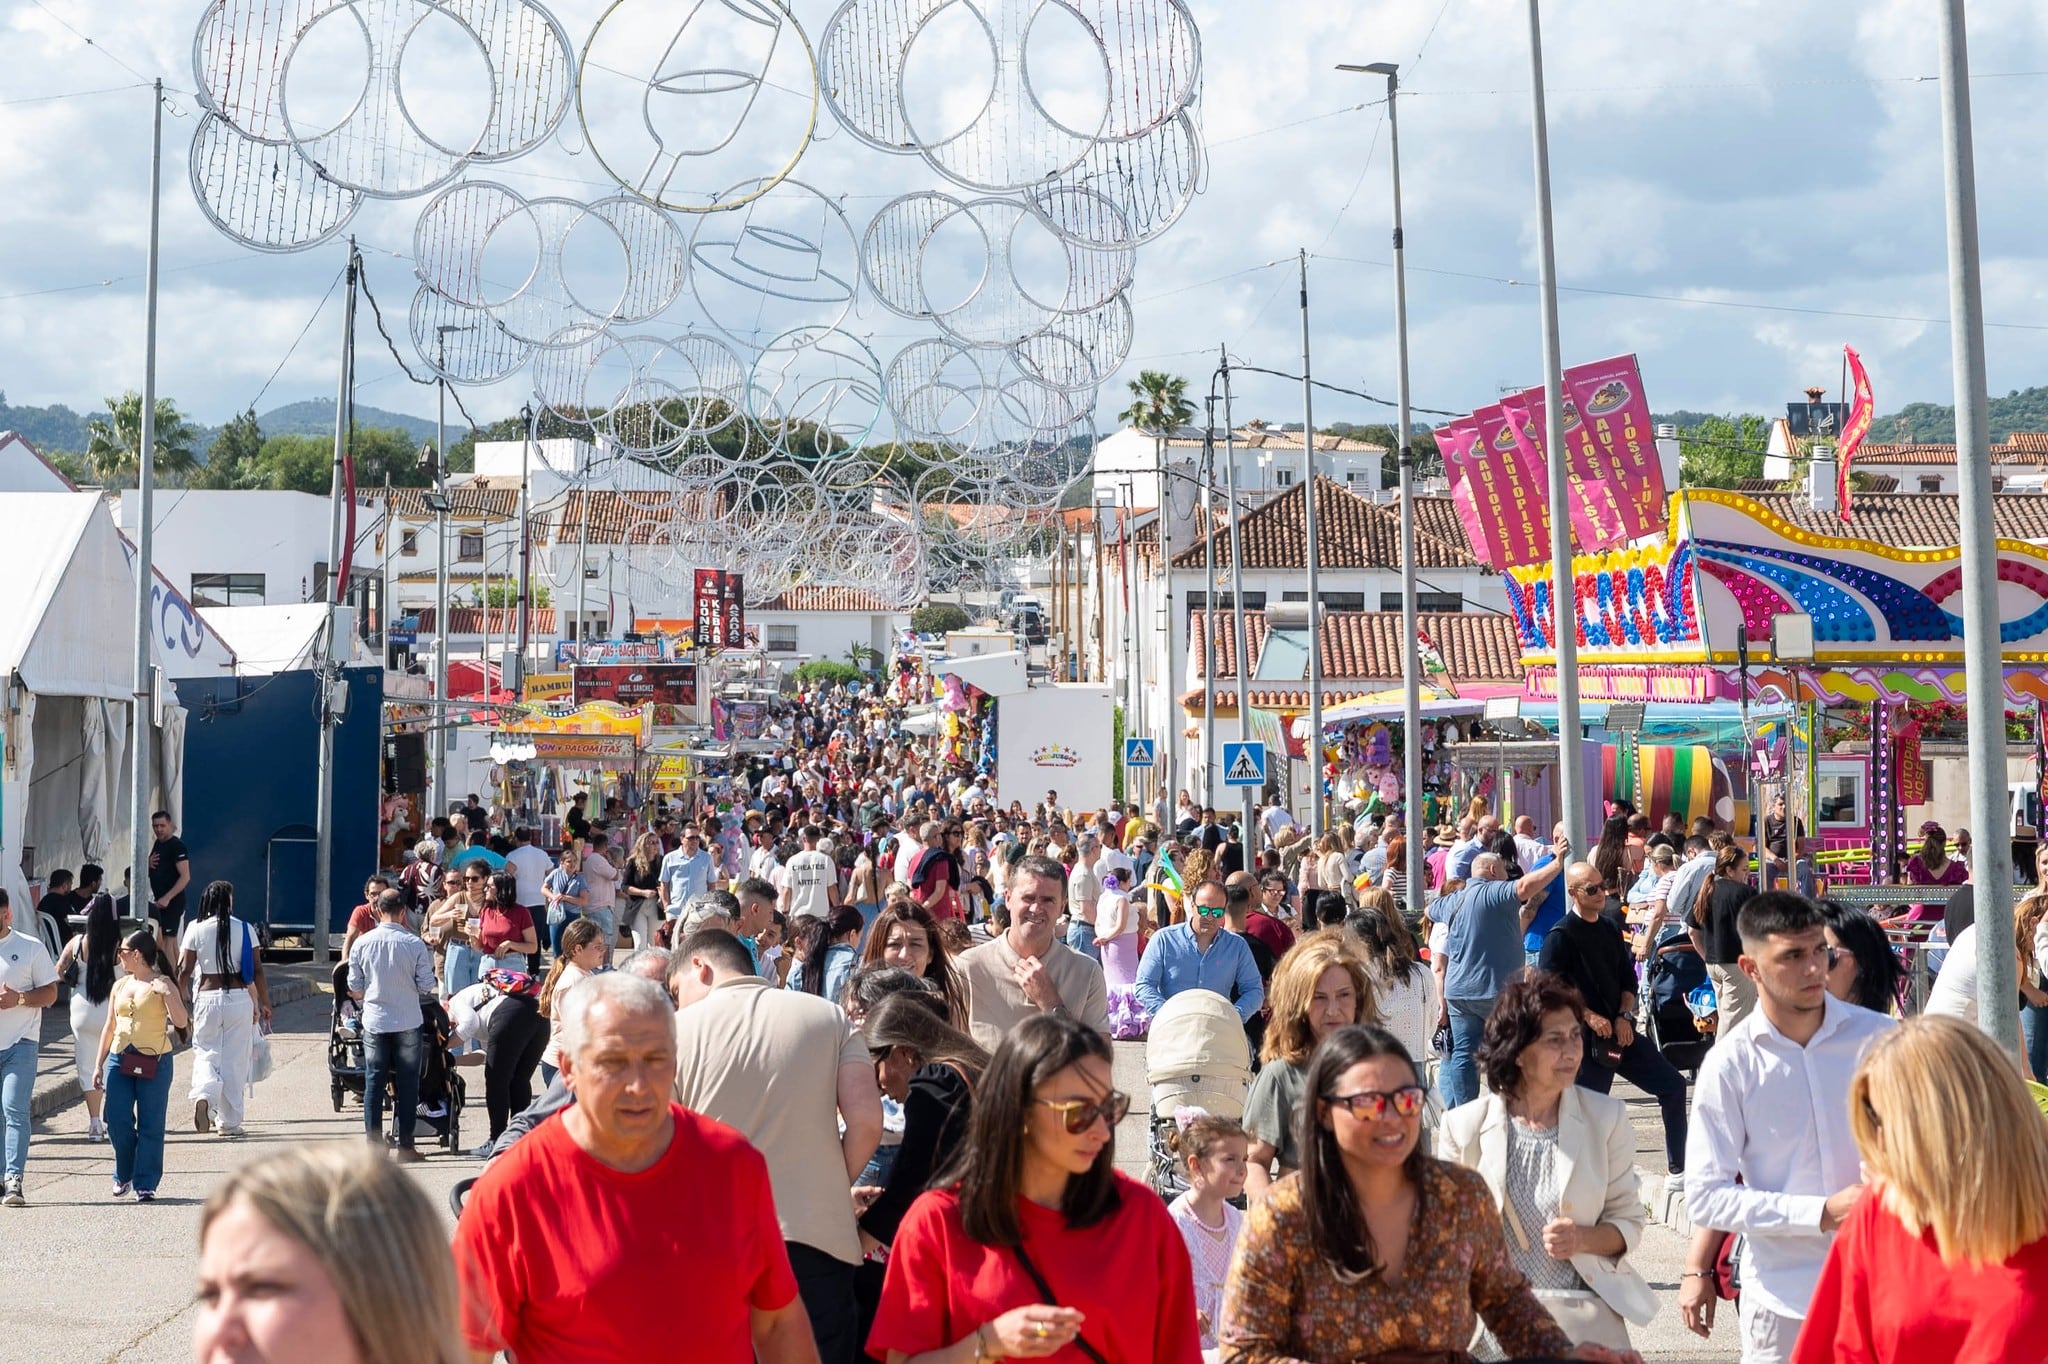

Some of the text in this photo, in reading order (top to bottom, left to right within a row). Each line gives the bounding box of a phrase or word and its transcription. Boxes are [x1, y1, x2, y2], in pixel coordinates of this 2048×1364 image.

[1478, 460, 1515, 562] AUTOPISTA
[1502, 452, 1540, 558] AUTOPISTA
[698, 598, 710, 644] DONER
[712, 599, 721, 645] KEBAB
[564, 743, 622, 754] PALOMITAS
